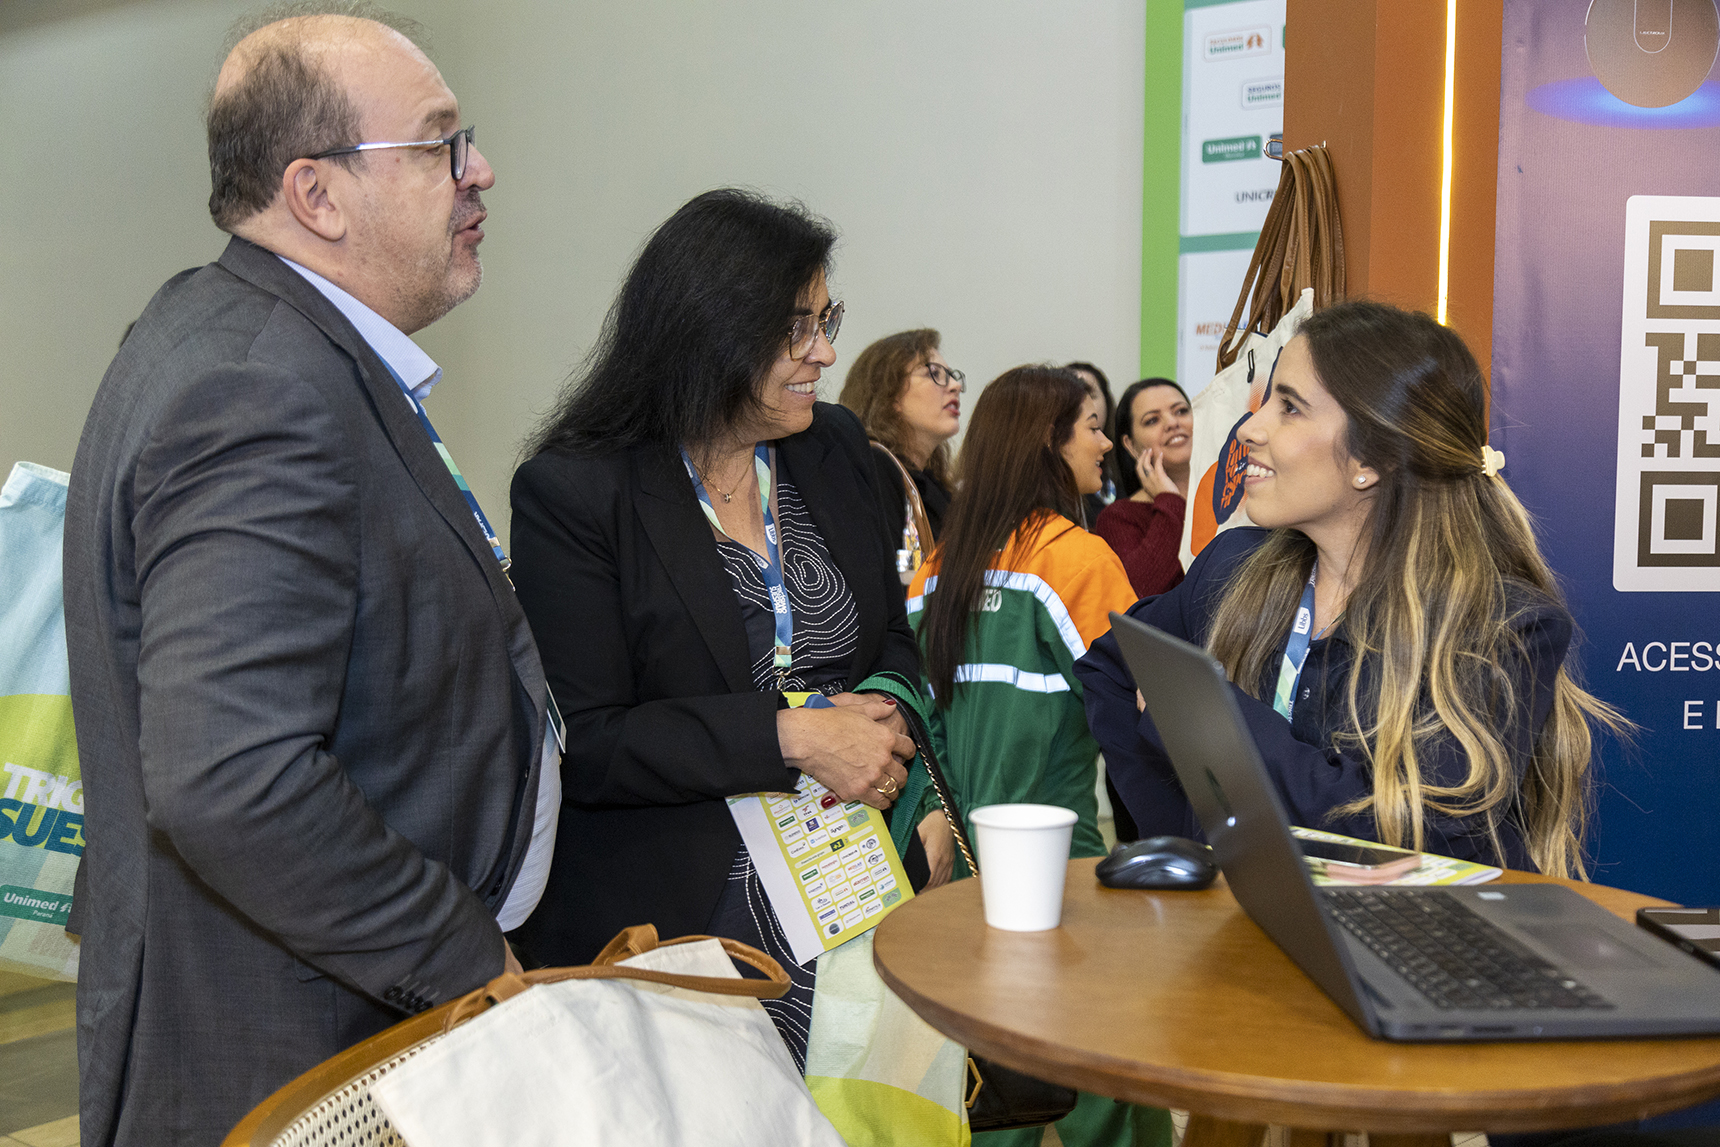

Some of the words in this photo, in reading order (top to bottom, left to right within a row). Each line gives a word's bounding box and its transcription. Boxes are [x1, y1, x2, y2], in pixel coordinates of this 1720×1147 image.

[1207, 141, 1245, 155] Unimed
[1616, 641, 1720, 672] ACES
[1683, 700, 1704, 730] E
[3, 892, 60, 911] Unimed
[32, 909, 54, 919] Paraná
